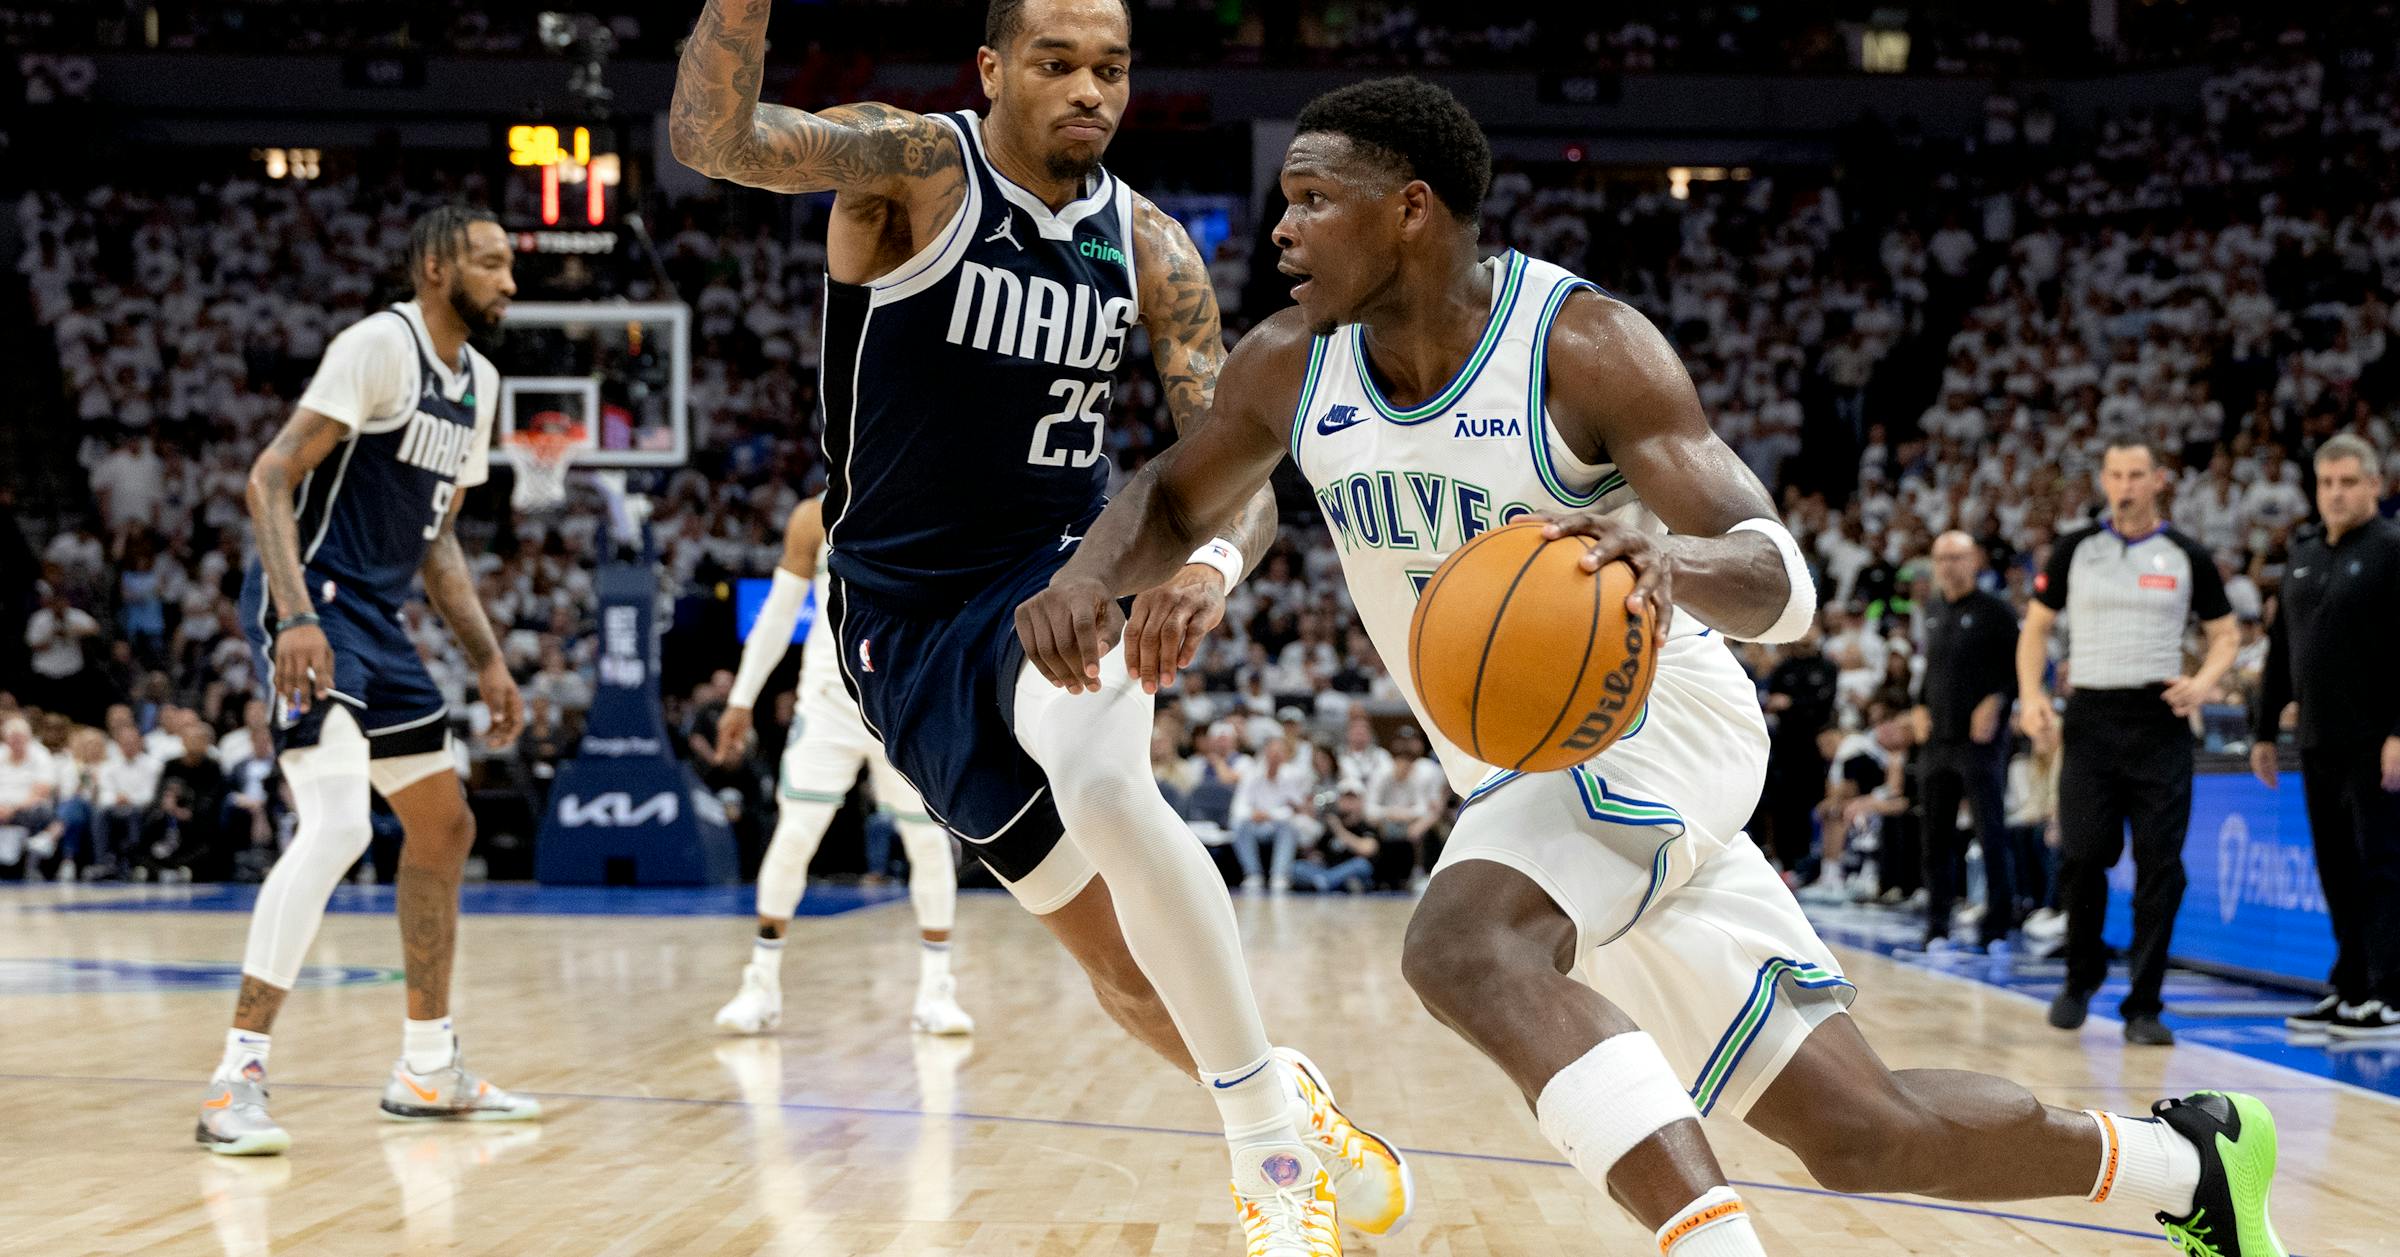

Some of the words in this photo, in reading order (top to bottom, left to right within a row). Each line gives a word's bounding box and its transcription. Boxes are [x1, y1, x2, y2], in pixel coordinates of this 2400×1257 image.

[946, 259, 1135, 372] MAVS
[1027, 379, 1112, 468] 25
[1326, 404, 1359, 425] NIKE
[1316, 471, 1535, 555] WOLVE
